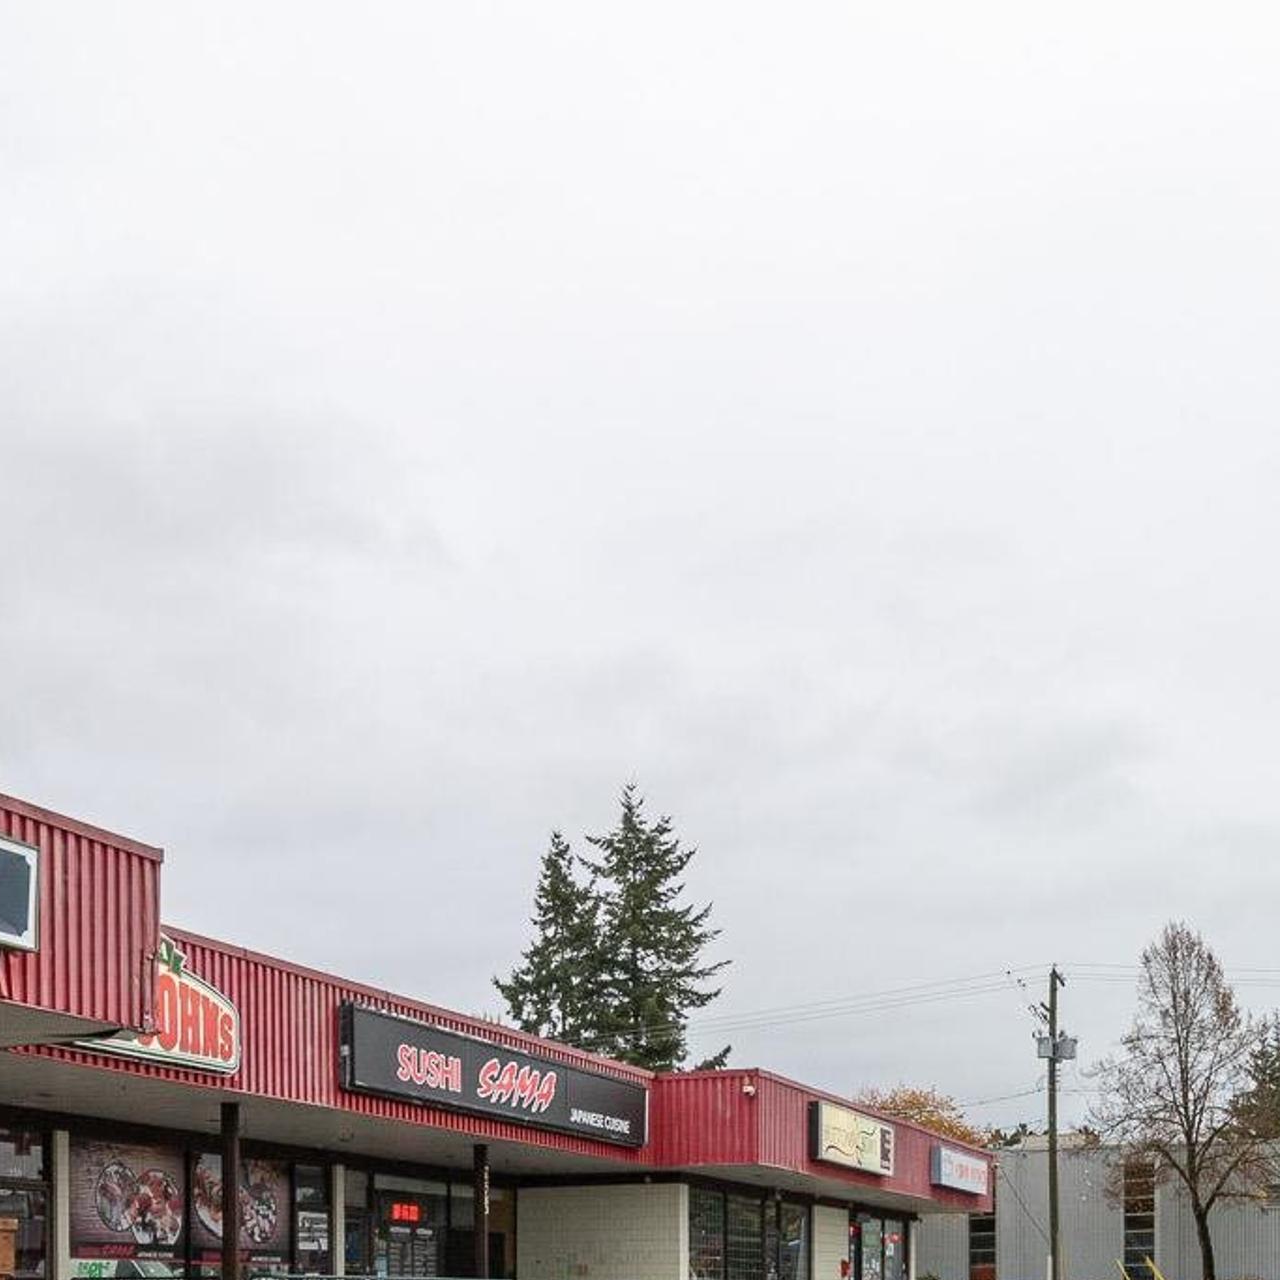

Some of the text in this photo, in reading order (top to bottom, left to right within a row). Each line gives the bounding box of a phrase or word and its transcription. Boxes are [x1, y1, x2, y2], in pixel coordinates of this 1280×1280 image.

[396, 1042, 558, 1114] SUSHI SAMA
[570, 1107, 631, 1134] JAPANESE CUISINE
